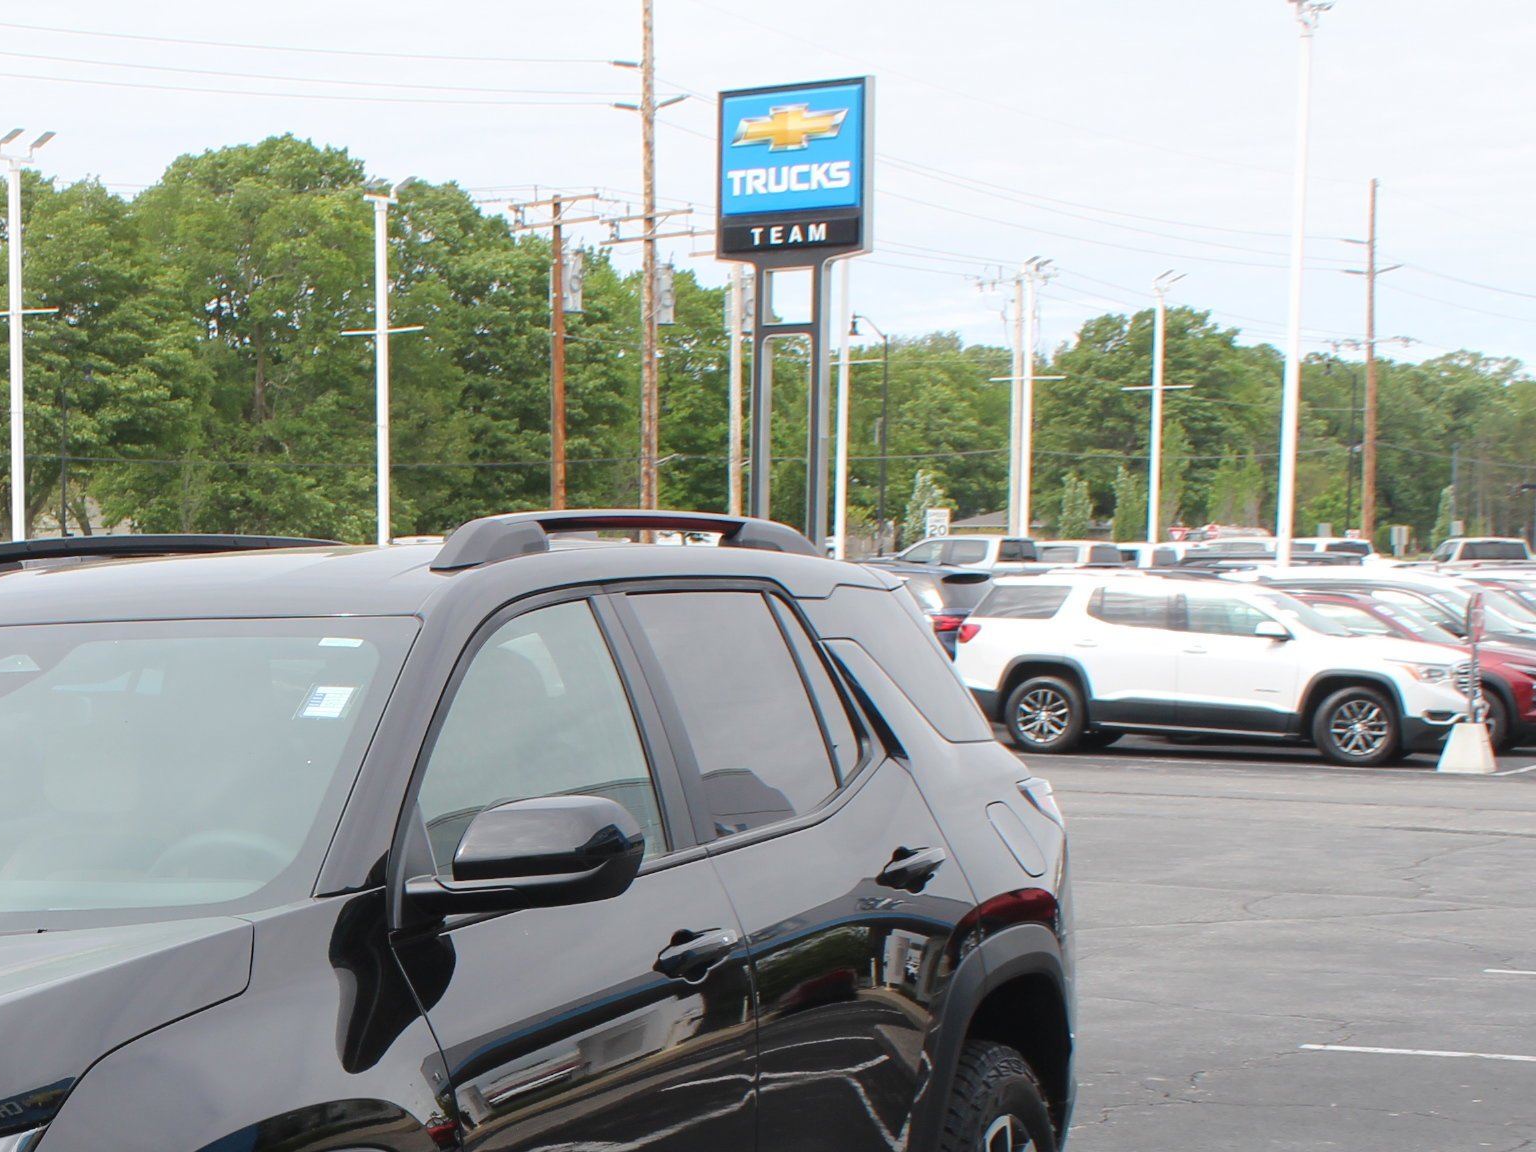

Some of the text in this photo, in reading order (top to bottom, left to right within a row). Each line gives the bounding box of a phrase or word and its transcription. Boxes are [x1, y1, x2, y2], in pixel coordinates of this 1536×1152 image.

[727, 160, 852, 196] TRUCKS
[750, 222, 827, 245] TEAM
[928, 524, 947, 537] 20
